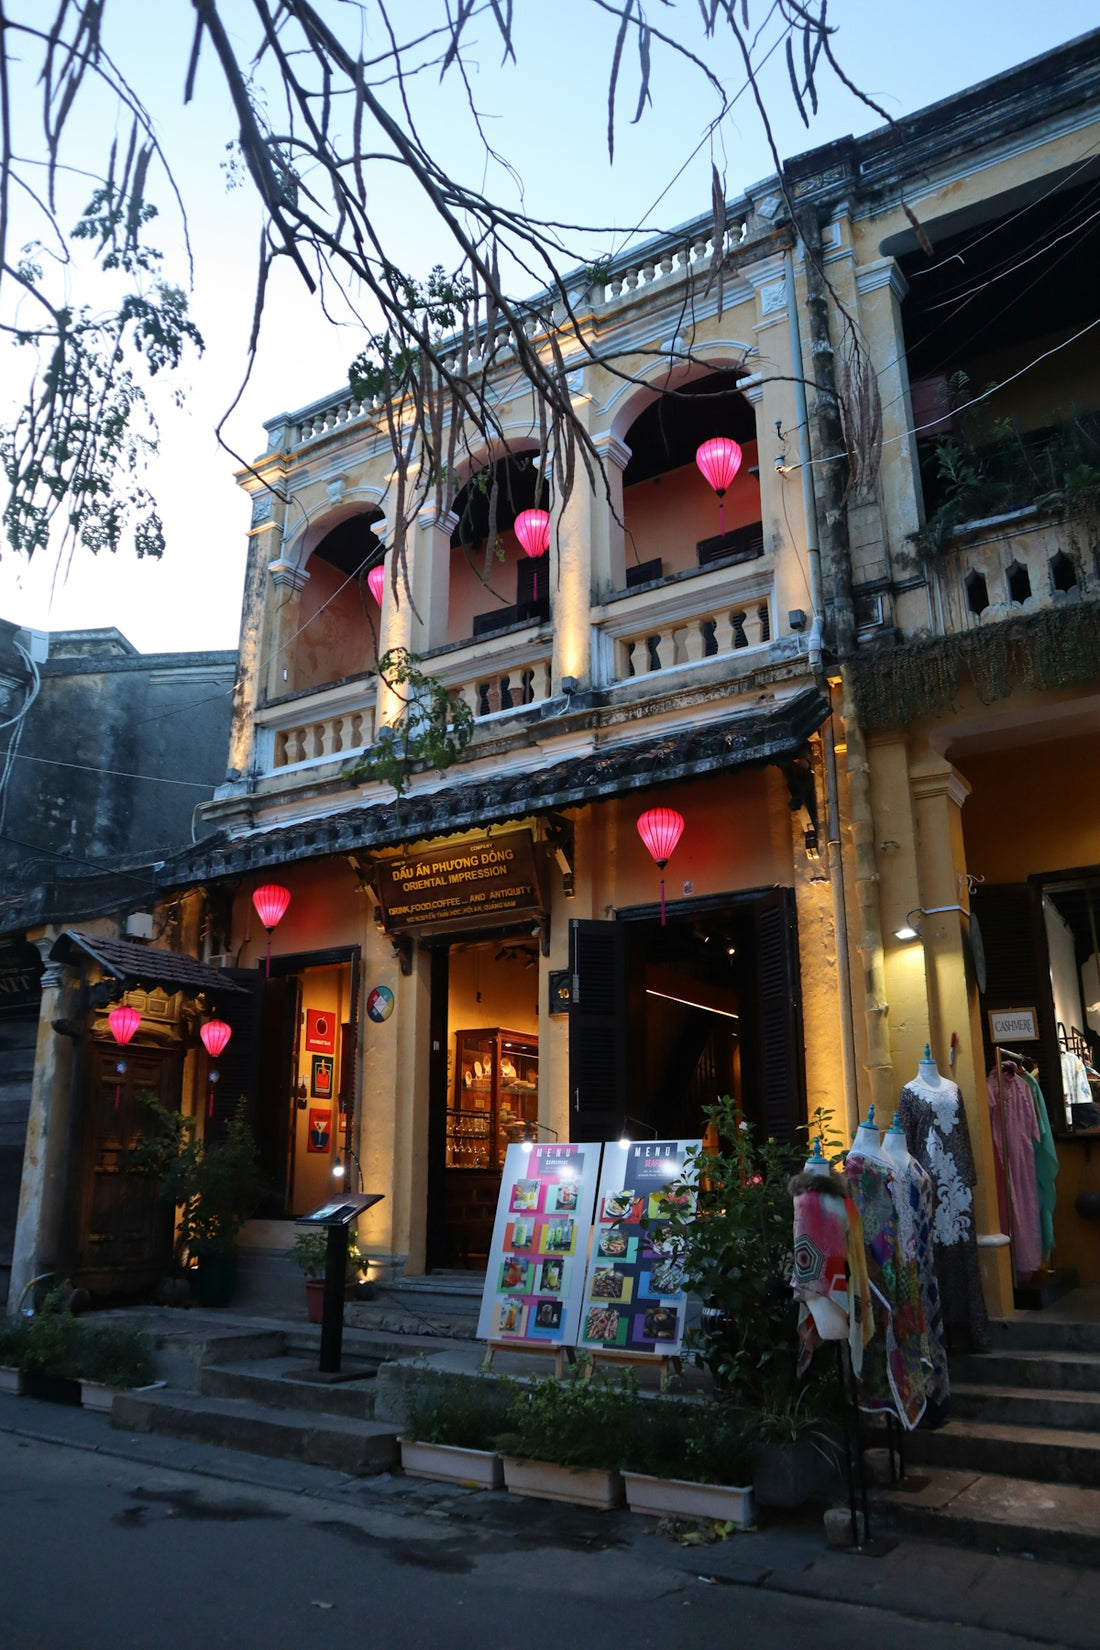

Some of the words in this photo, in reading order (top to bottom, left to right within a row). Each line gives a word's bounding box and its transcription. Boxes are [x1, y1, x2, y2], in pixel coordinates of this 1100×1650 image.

[470, 842, 494, 852] COMPANY
[391, 864, 414, 882] DẤU
[415, 862, 431, 877] ẤN
[431, 855, 480, 874] PHƯƠNG
[480, 848, 515, 865] ĐÔNG
[402, 876, 449, 893] ORIENTAL
[448, 864, 508, 885] IMPRESSION
[469, 892, 486, 903] AND
[489, 885, 532, 900] ANTIQUITY
[994, 1019, 1032, 1033] CASHMERE
[536, 1147, 571, 1158] MENU
[634, 1146, 671, 1158] MENU
